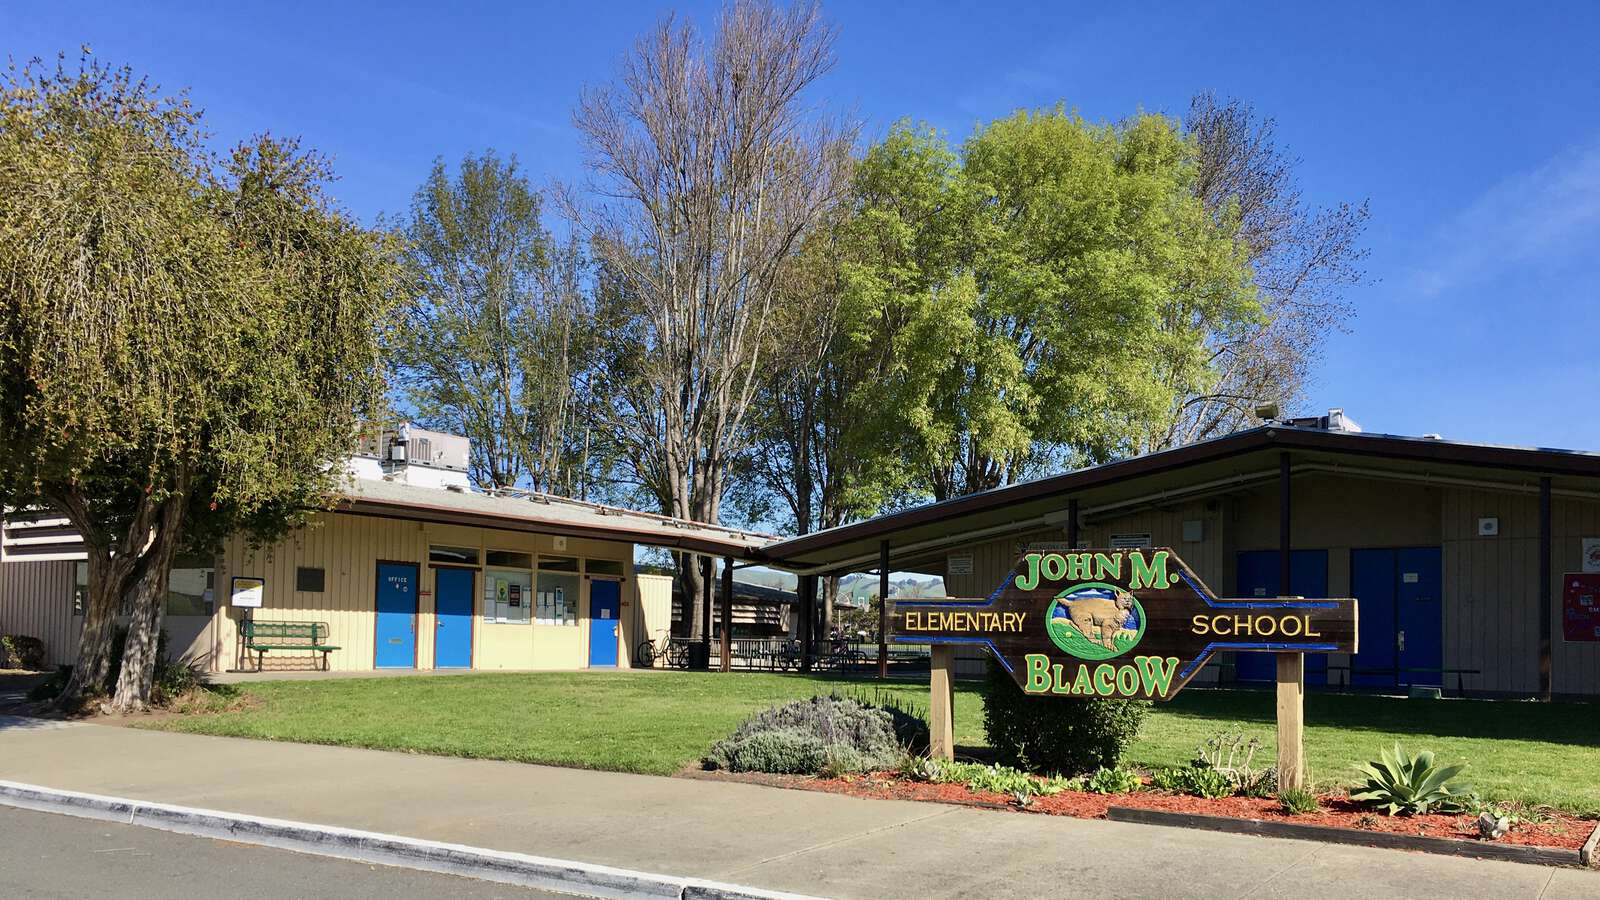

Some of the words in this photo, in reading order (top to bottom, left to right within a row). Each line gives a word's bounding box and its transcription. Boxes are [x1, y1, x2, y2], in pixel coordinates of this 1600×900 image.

[1015, 553, 1122, 591] JOHN
[1129, 551, 1179, 590] M.
[905, 611, 1026, 632] ELEMENTARY
[1192, 614, 1320, 637] SCHOOL
[1024, 654, 1179, 697] BLACOW
